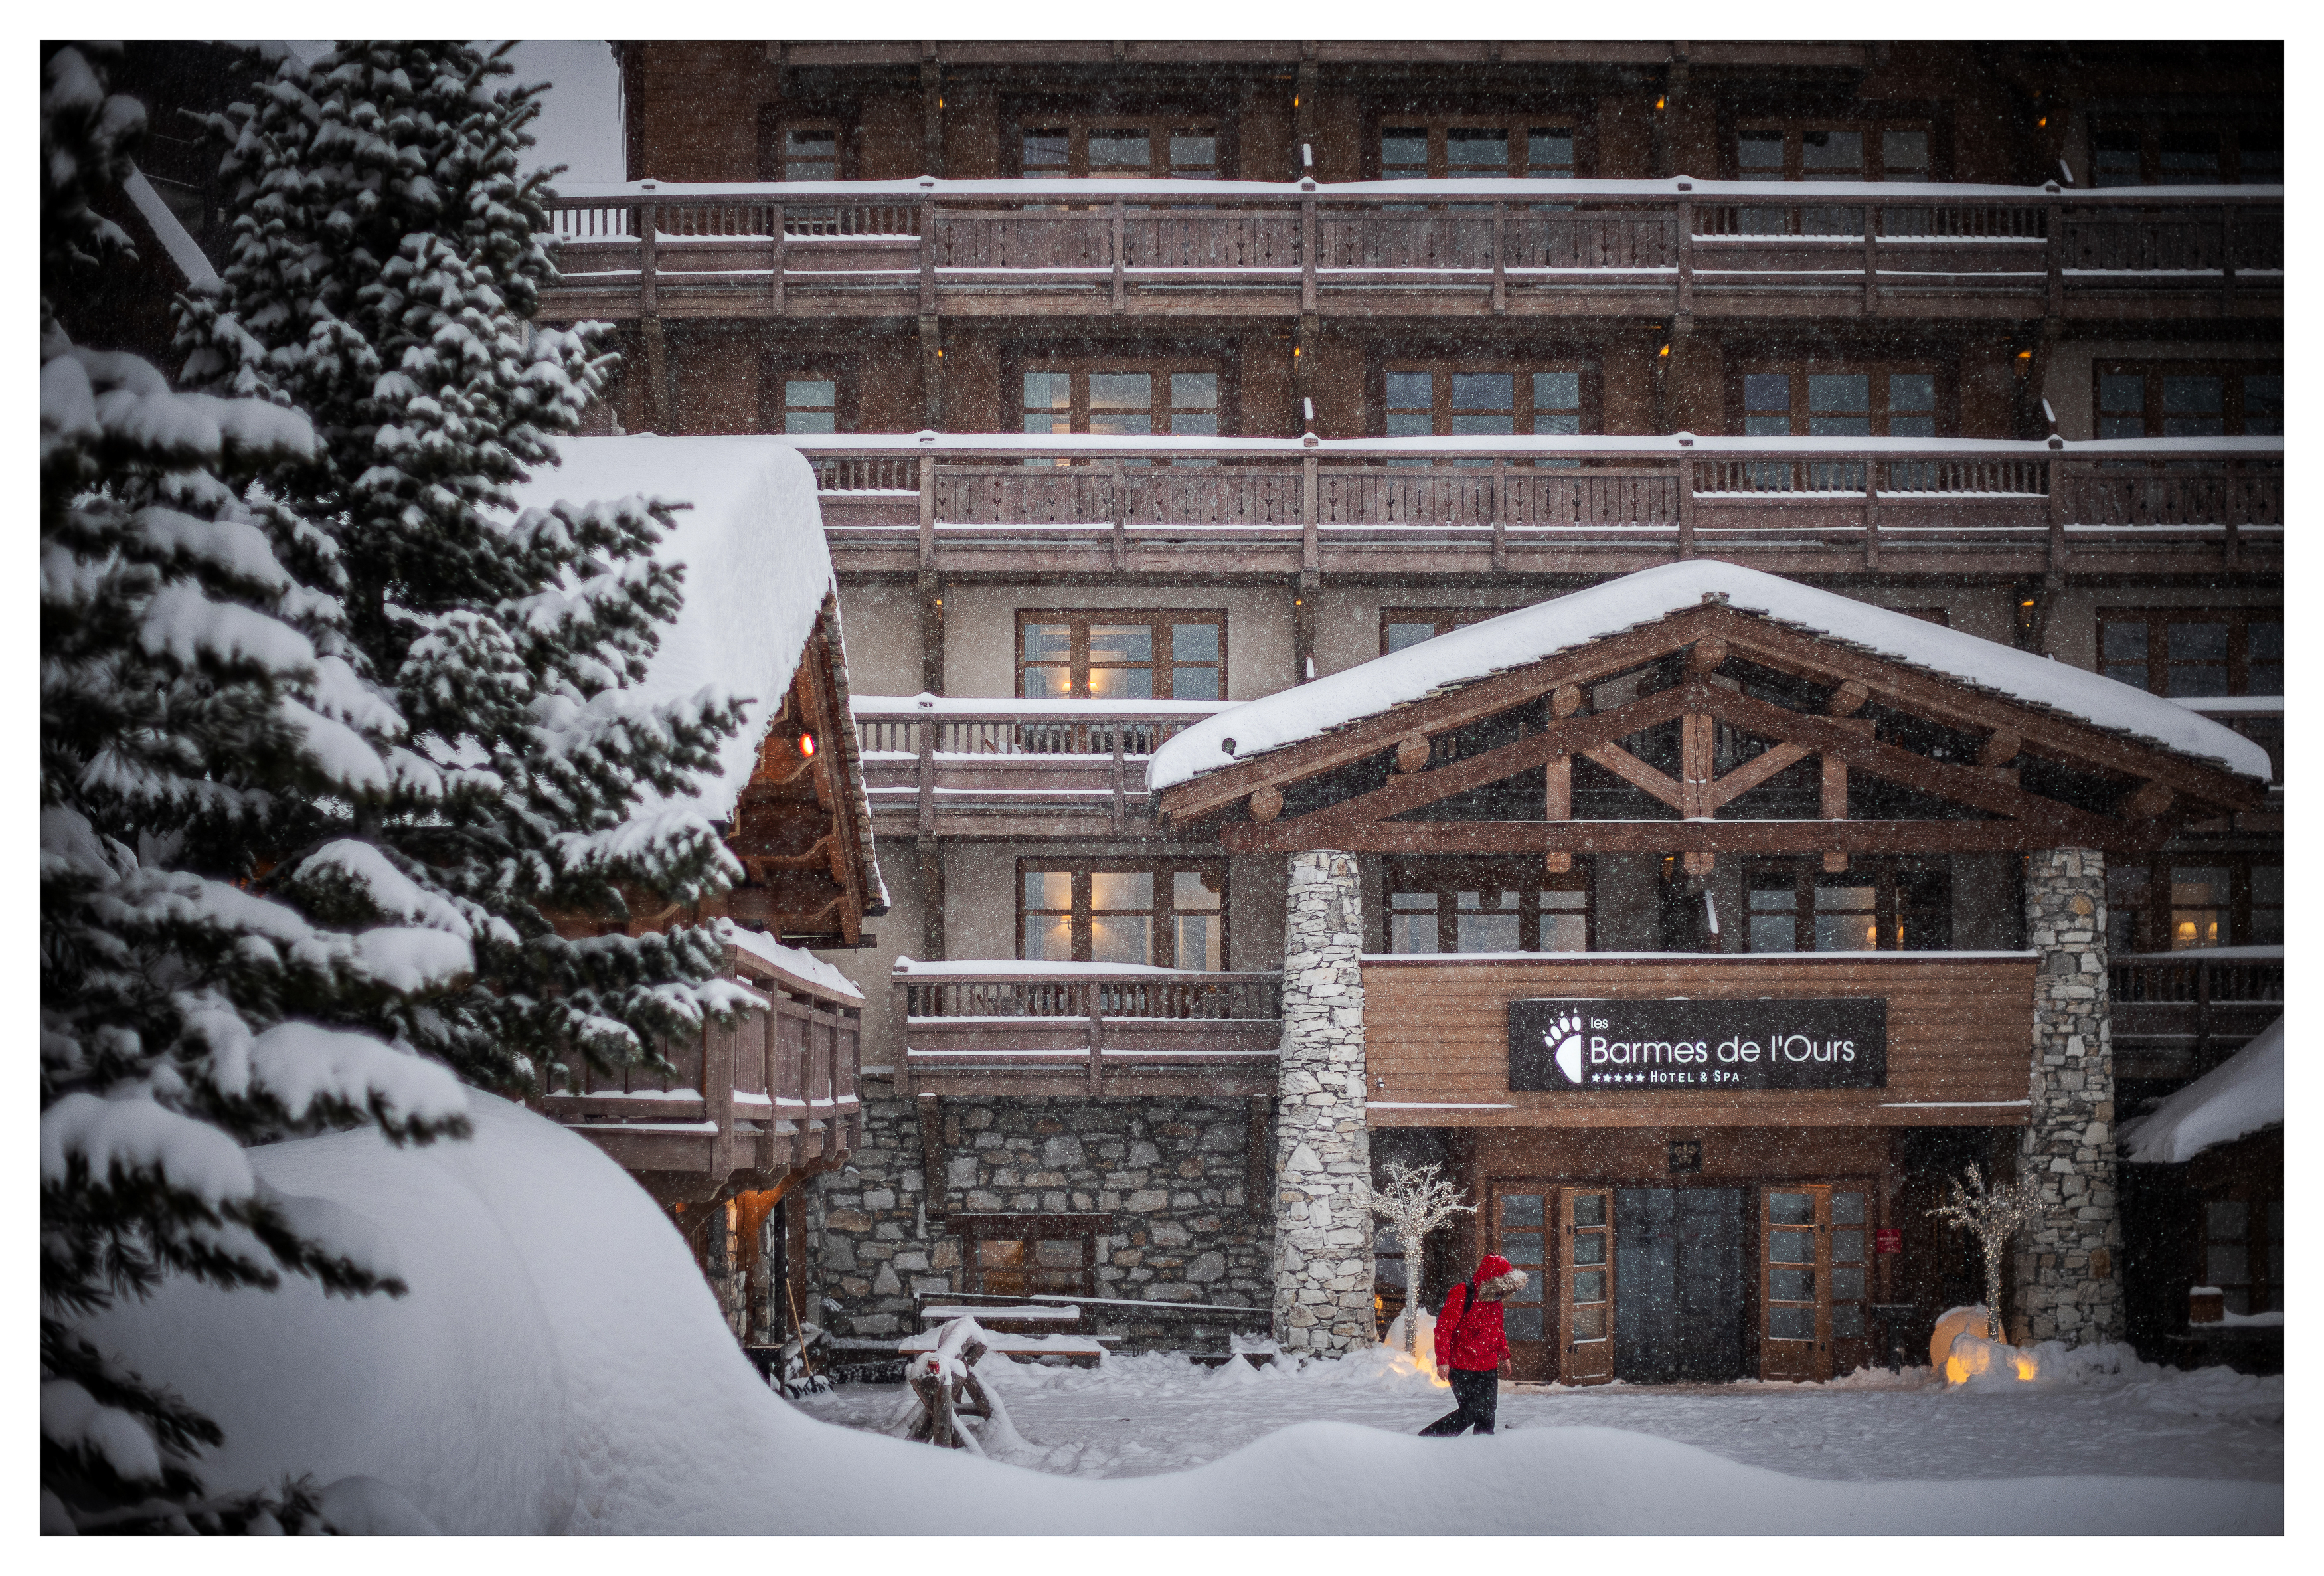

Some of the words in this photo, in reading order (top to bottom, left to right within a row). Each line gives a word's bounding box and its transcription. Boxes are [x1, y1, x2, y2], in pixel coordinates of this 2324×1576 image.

[1591, 1017, 1609, 1030] les
[1590, 1035, 1708, 1064] Barmes
[1717, 1034, 1761, 1063] de
[1771, 1035, 1855, 1063] l'Ours
[1649, 1070, 1695, 1083] HOTEL
[1699, 1071, 1708, 1083] &
[1712, 1069, 1740, 1083] SPA
